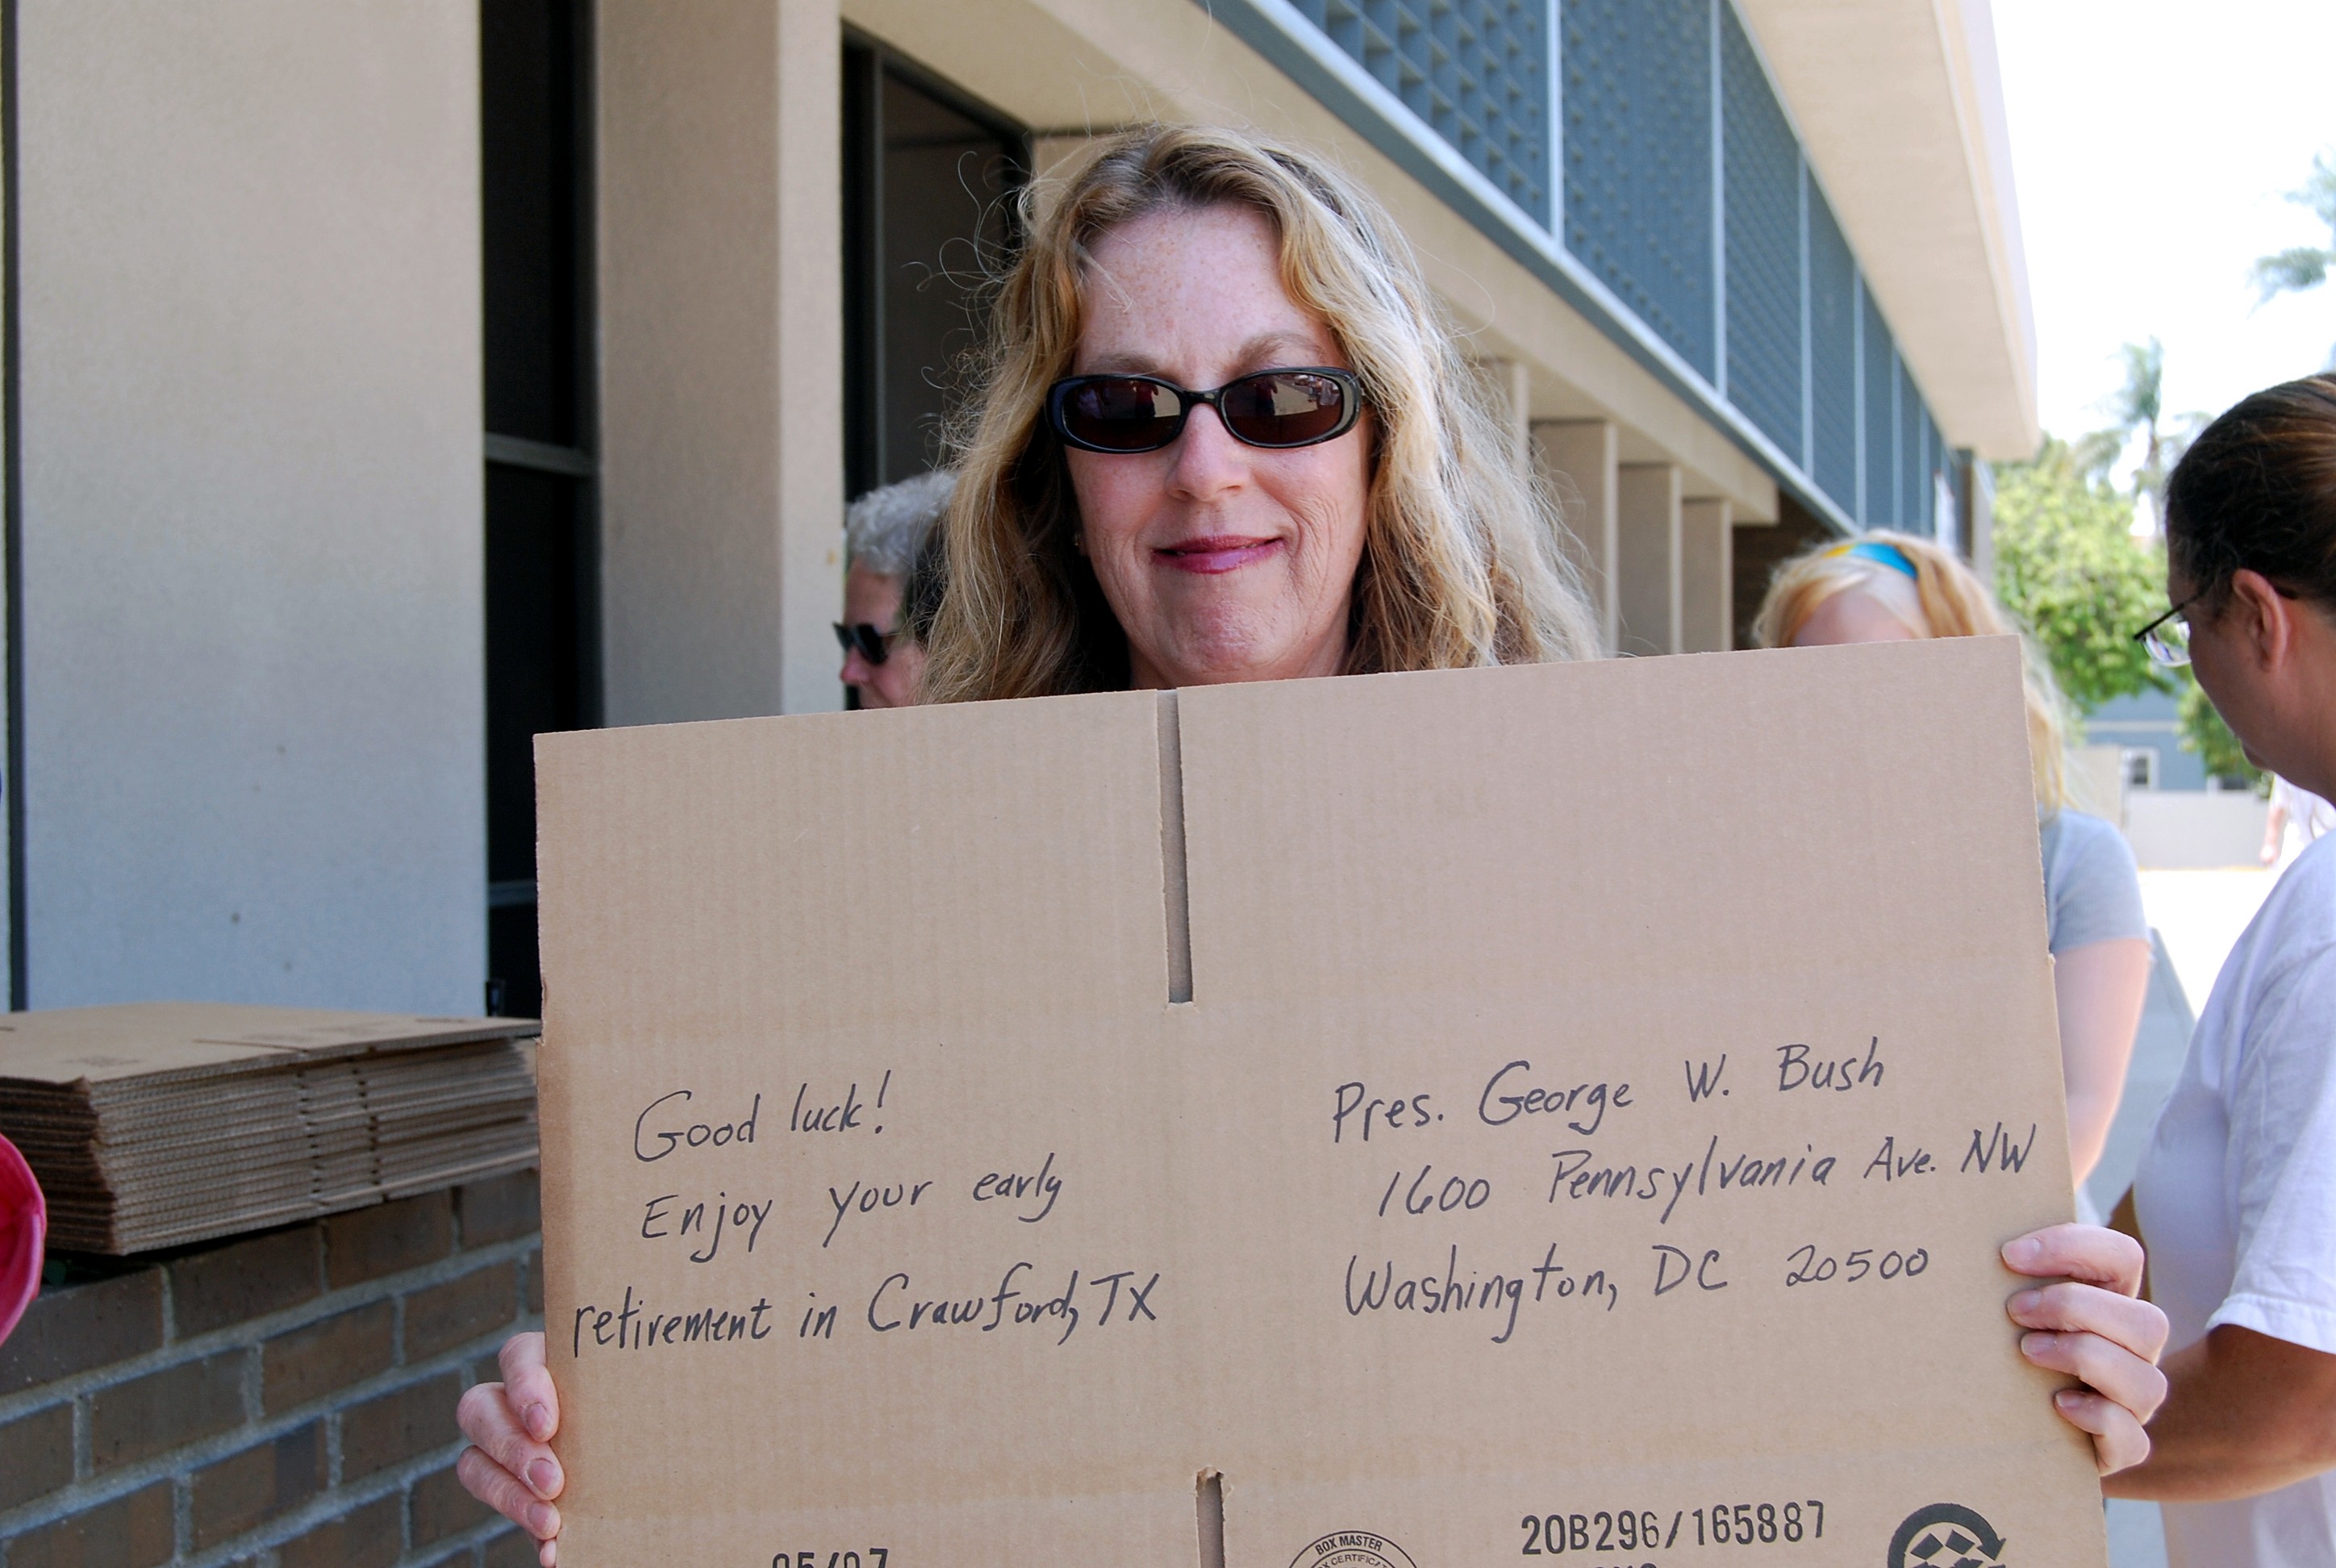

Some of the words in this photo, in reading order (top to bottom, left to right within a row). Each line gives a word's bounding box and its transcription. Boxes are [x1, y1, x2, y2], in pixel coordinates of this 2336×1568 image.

[635, 1091, 761, 1162] Good
[791, 1070, 891, 1134] luck!
[1333, 1075, 1443, 1143] Pres.
[1479, 1061, 1633, 1135] George
[1685, 1054, 1729, 1102] W.
[1777, 1036, 1883, 1091] Bush
[642, 1192, 772, 1263] Enjoy
[823, 1181, 932, 1248] your
[973, 1153, 1062, 1223] early
[1379, 1165, 1490, 1216] 1600
[1549, 1136, 1836, 1224] Pennsylvania
[1863, 1136, 1936, 1182] Ave.
[1961, 1122, 2036, 1173] NW
[574, 1287, 772, 1357] retirement
[800, 1292, 836, 1339] in
[868, 1262, 1078, 1345] Crawford,
[1091, 1272, 1160, 1326] TX
[1345, 1243, 1616, 1344] Washington,
[1652, 1245, 1727, 1296] DC
[1786, 1245, 1928, 1287] 20500
[1315, 1537, 1337, 1555] BOX
[1339, 1535, 1383, 1552] MASTER
[1521, 1500, 1824, 1554] 20B296/165887
